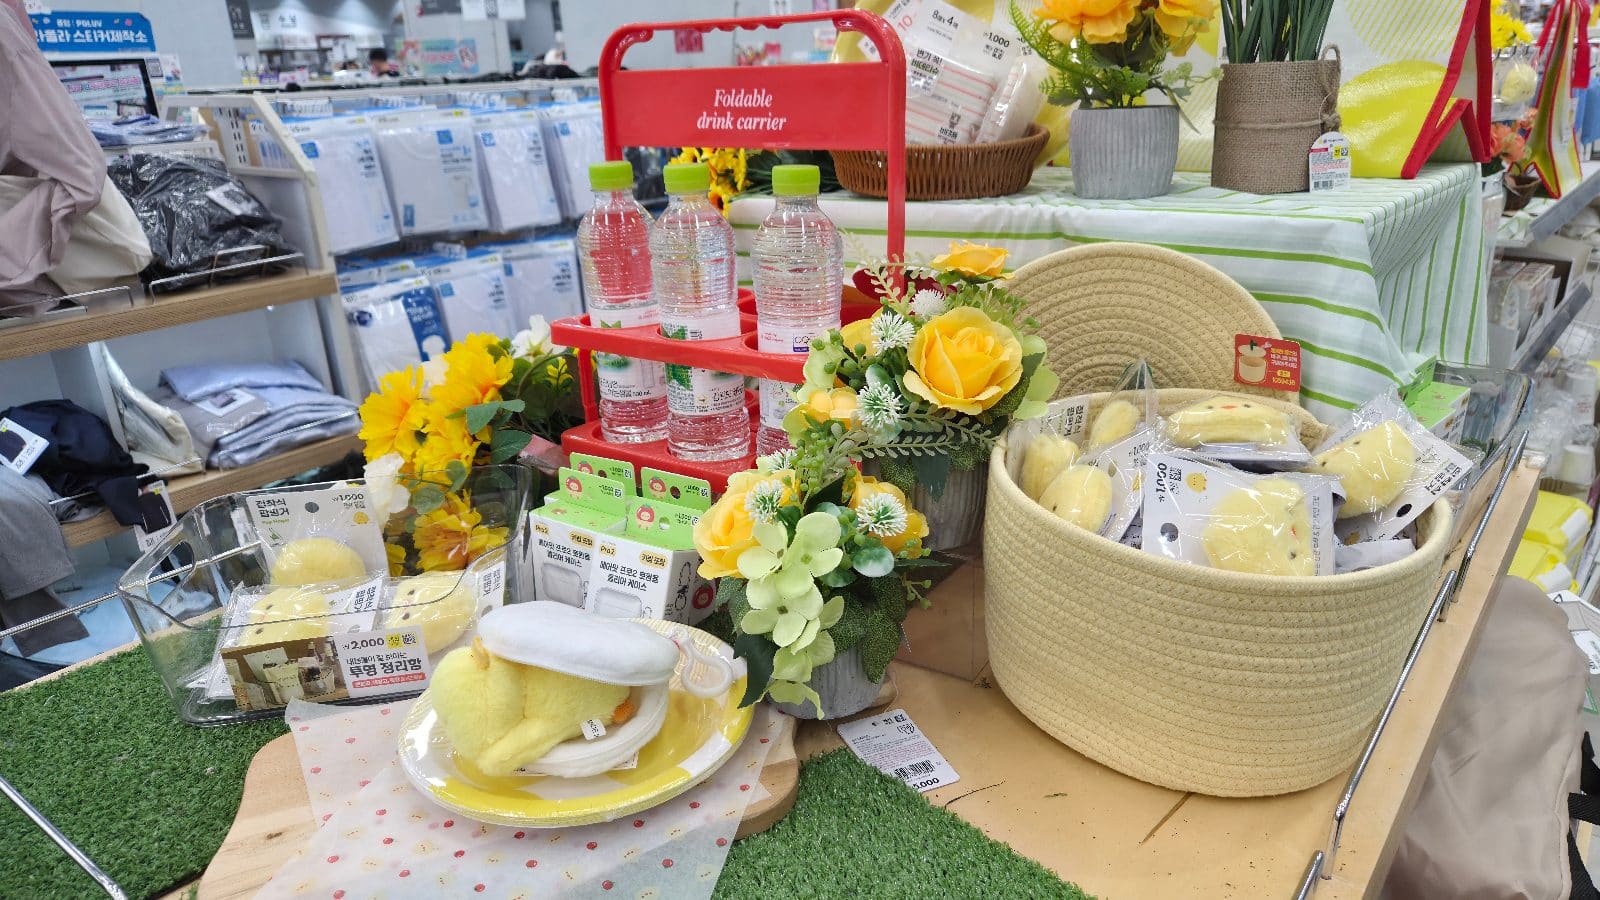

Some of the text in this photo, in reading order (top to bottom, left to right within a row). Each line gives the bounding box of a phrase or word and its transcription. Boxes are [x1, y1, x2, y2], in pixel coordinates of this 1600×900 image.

[714, 88, 773, 107] Foldable
[696, 111, 786, 130] drink carrier
[349, 658, 422, 678] 투명 정리함
